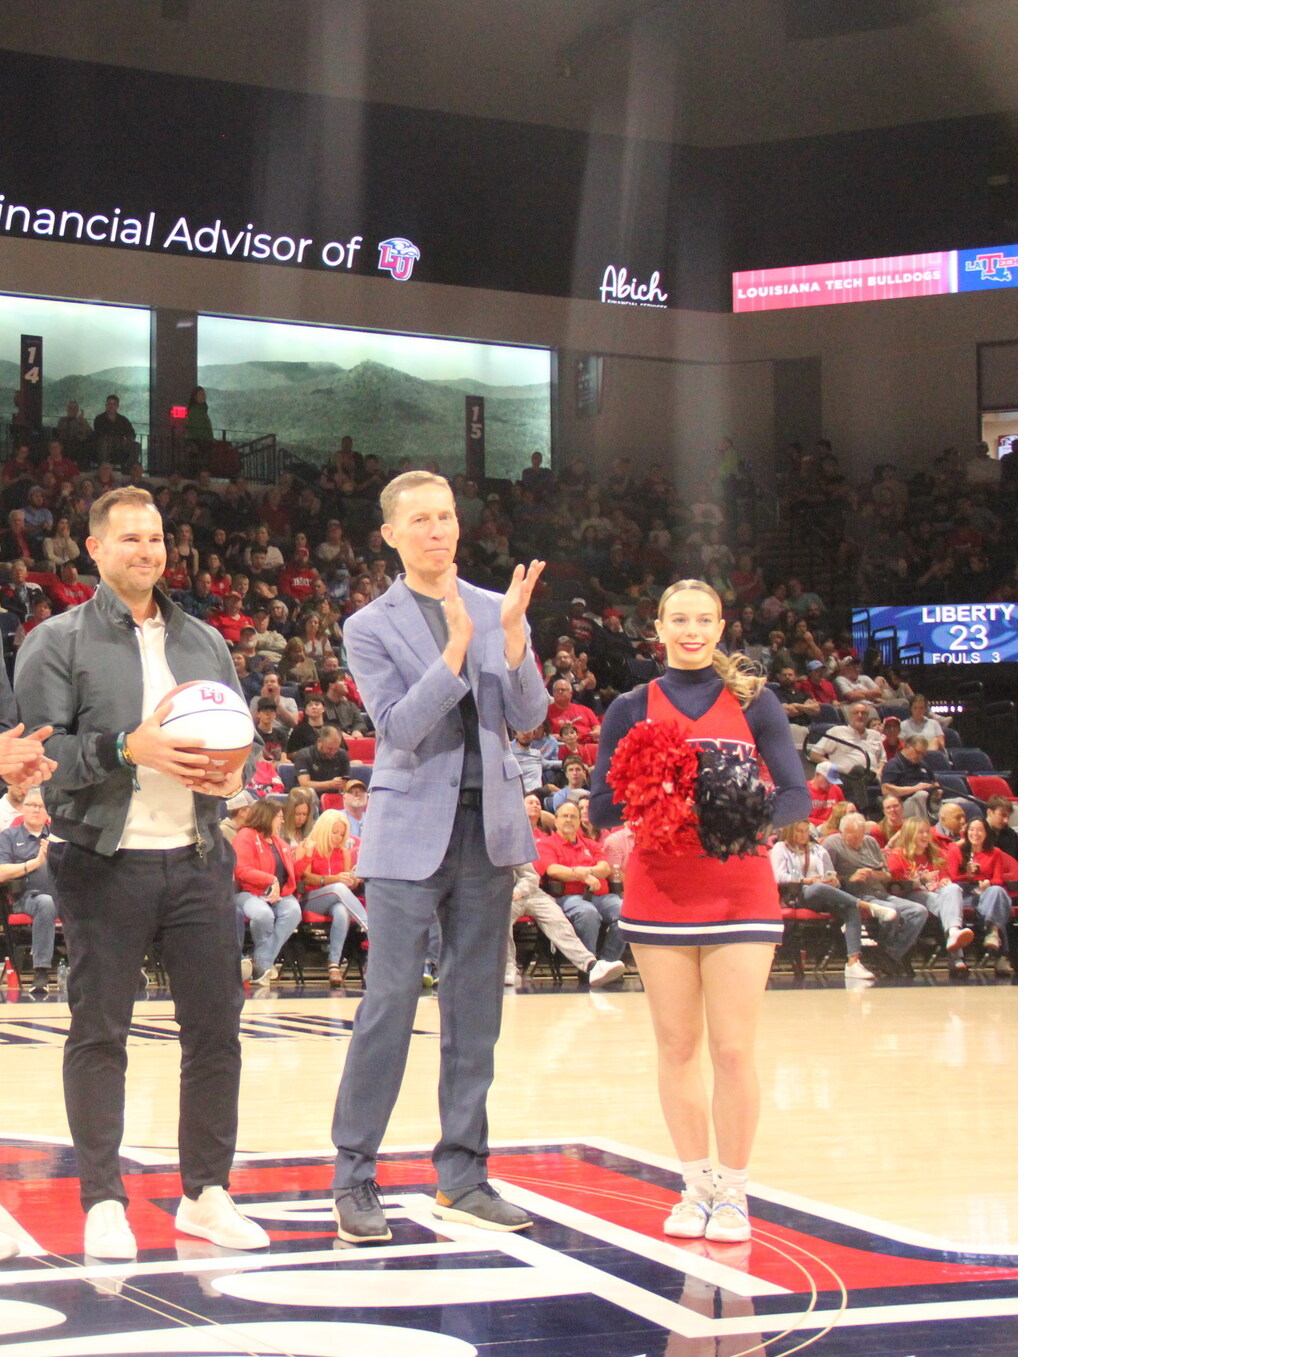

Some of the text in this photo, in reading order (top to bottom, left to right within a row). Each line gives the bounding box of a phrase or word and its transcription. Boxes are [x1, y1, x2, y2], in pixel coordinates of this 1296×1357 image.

[163, 217, 313, 263] Advisor
[321, 236, 363, 269] of
[599, 265, 668, 303] Abich
[737, 270, 941, 299] LOUISIANA TECH BULLDOGS
[922, 604, 1015, 623] LIBERTY
[949, 624, 989, 650] 23
[932, 651, 1001, 664] FOULS 3
